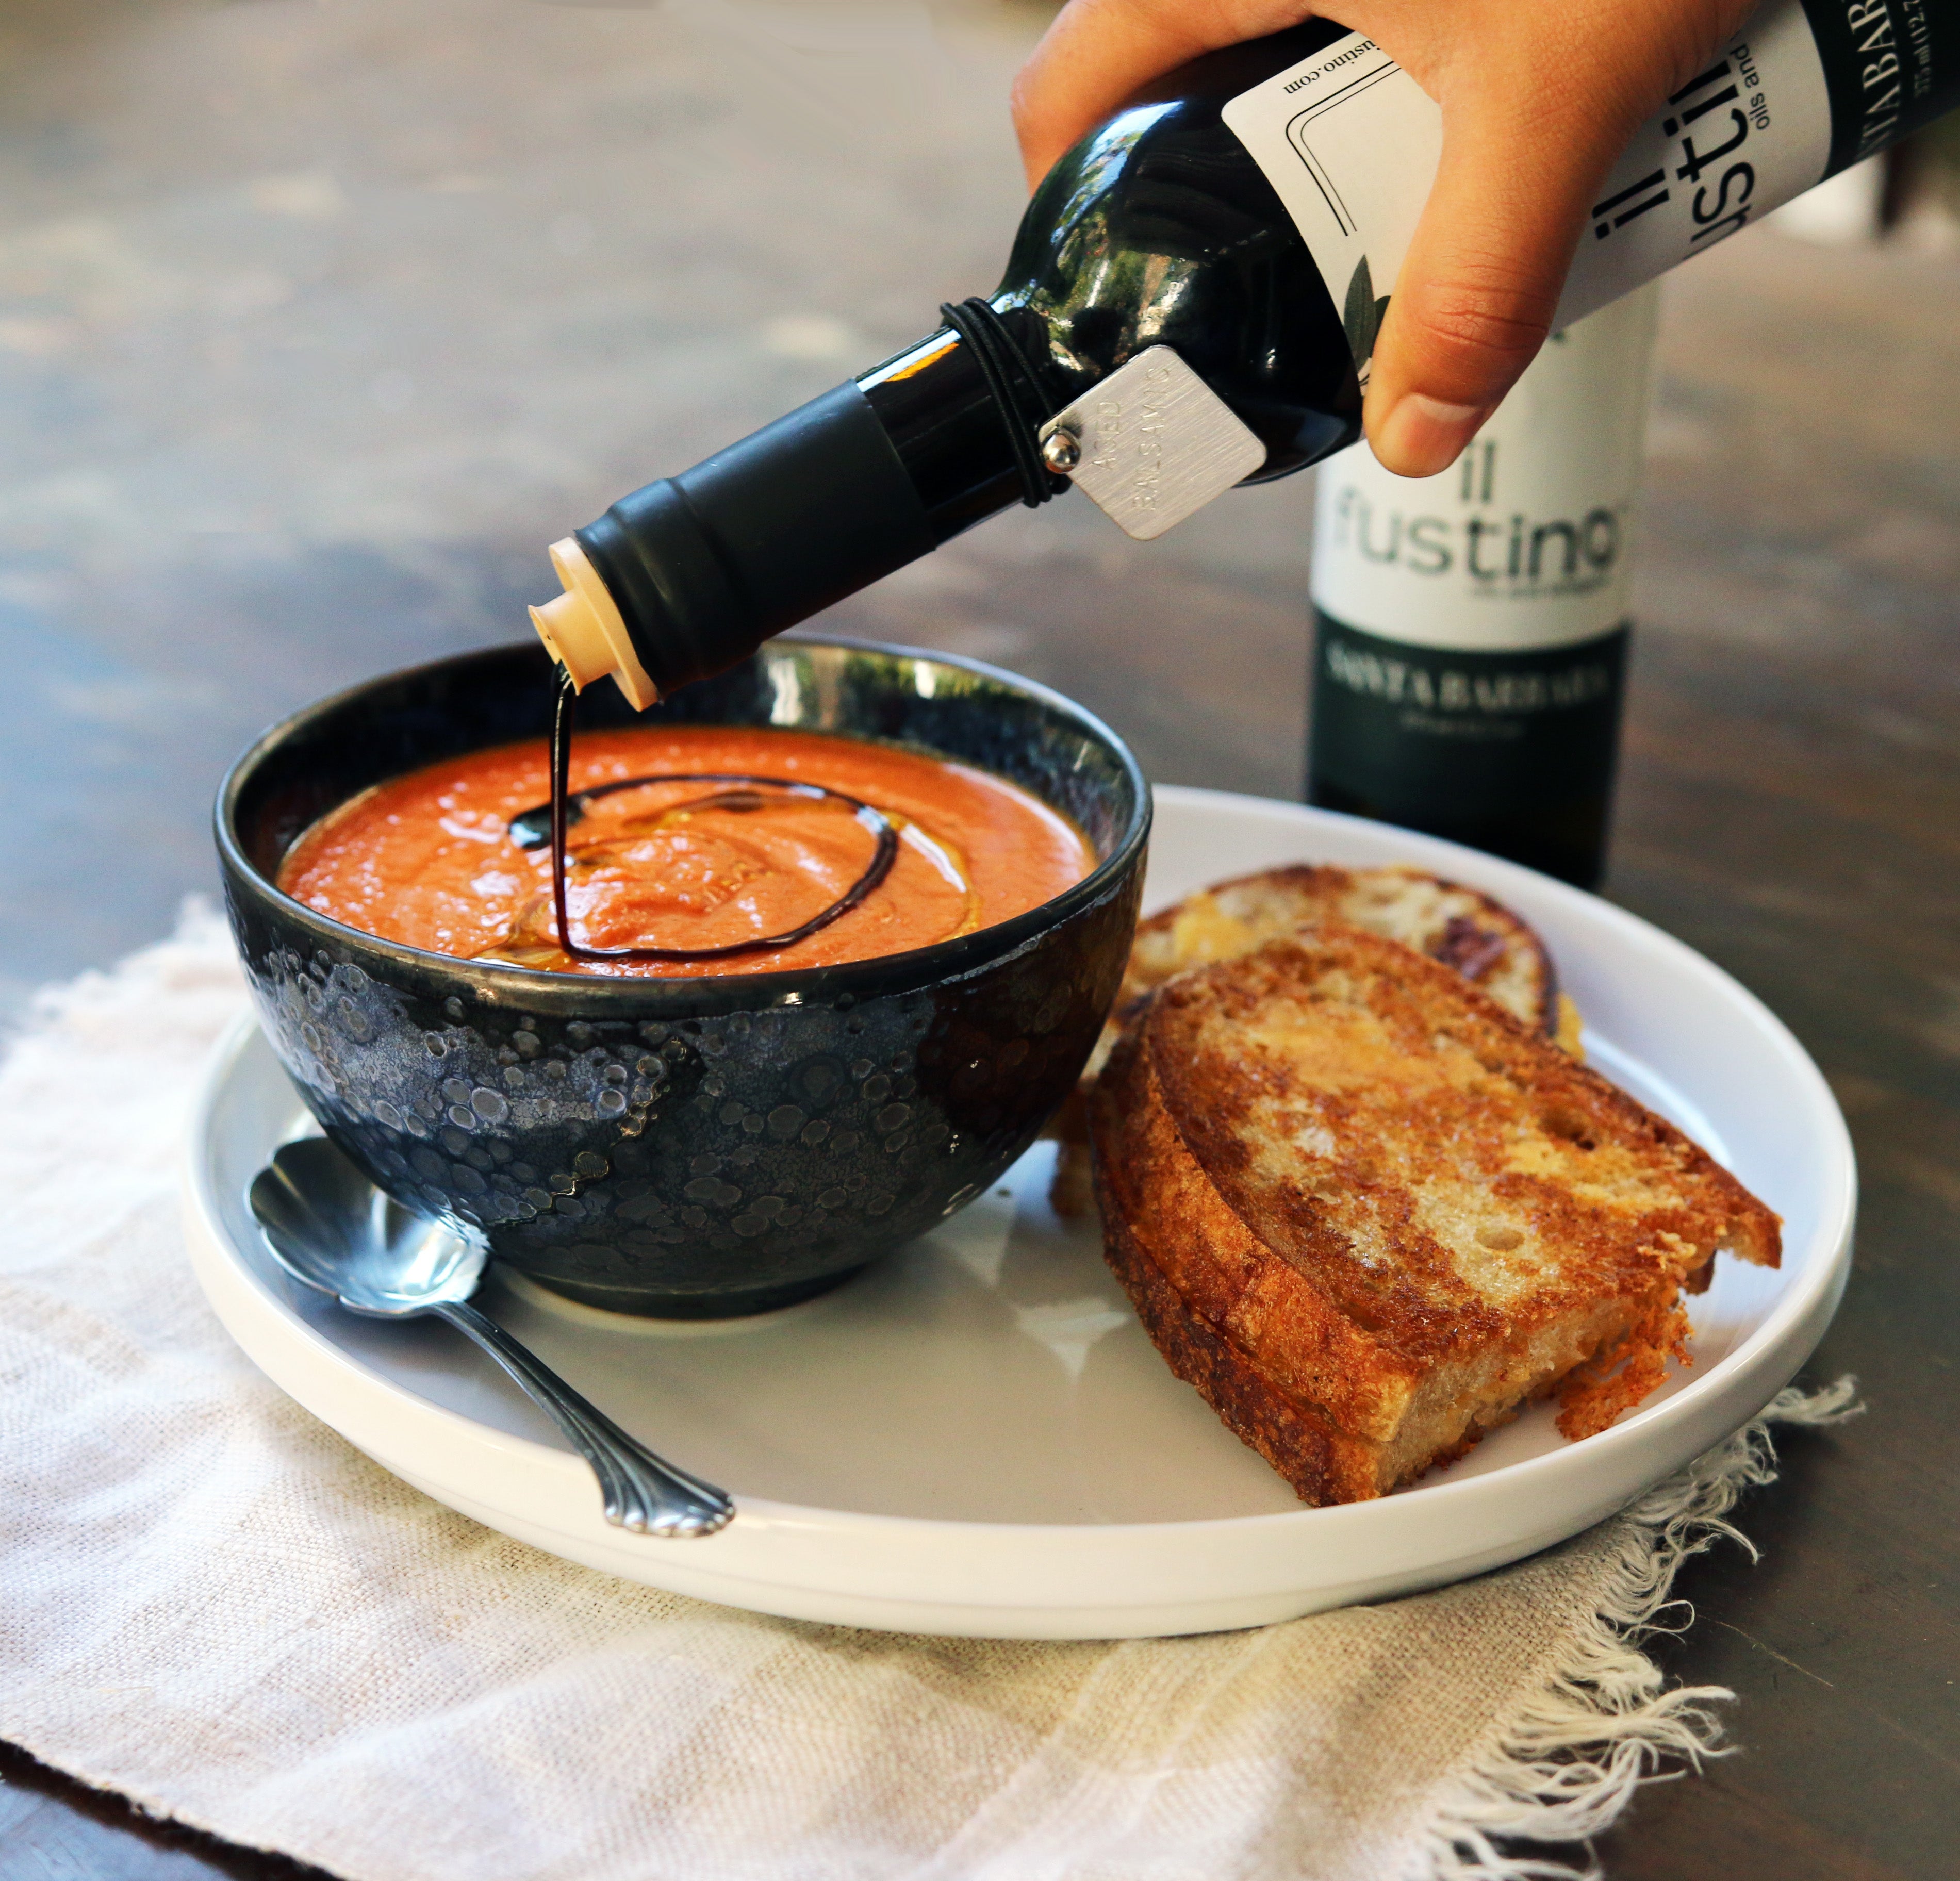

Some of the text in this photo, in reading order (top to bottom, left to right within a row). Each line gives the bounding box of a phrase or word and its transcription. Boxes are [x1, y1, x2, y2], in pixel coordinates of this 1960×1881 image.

[1283, 39, 1380, 94] ustino.com
[1729, 43, 1771, 130] oils and
[1592, 168, 1669, 240] il
[1092, 401, 1121, 471] AGED
